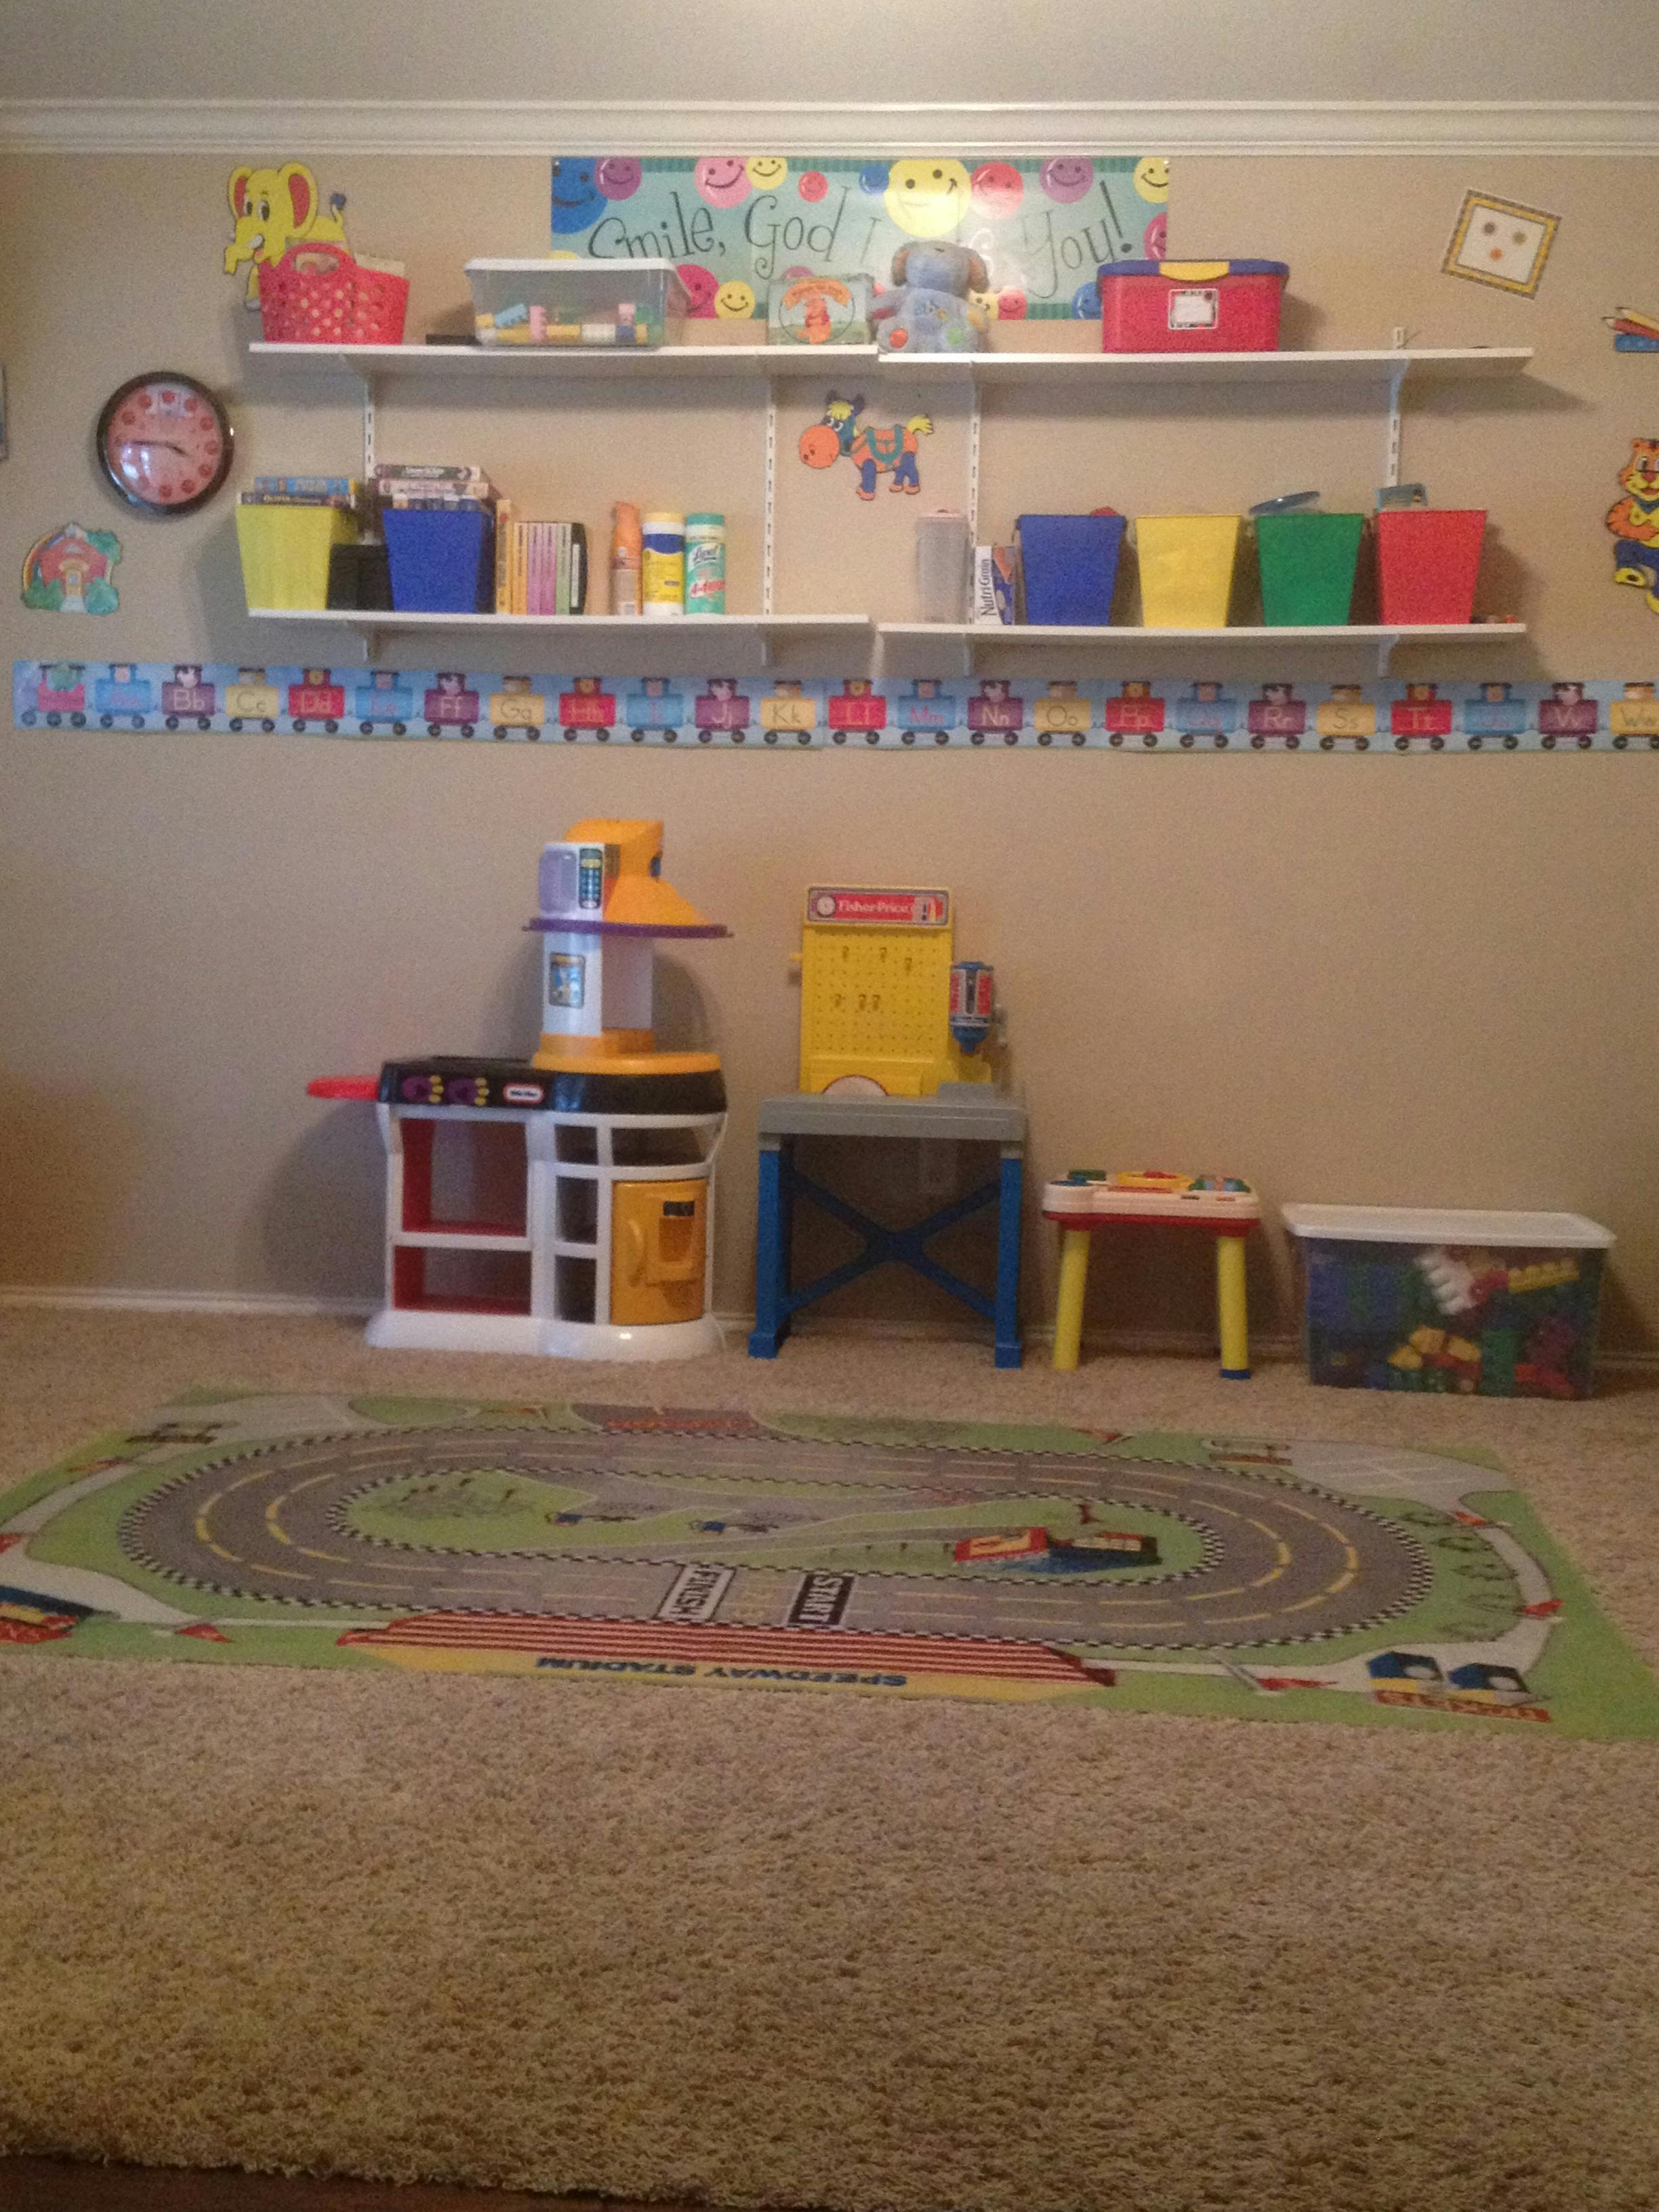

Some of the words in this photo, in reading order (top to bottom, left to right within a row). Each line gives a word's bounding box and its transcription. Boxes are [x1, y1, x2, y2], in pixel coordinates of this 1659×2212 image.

[744, 185, 853, 279] God
[1020, 180, 1132, 298] You!
[173, 689, 205, 712] Bb
[237, 691, 267, 713] Cc
[772, 700, 802, 724] Kk
[982, 704, 1010, 726] Nn
[1046, 704, 1079, 727] Oo
[1332, 707, 1359, 729] Ss
[669, 1568, 723, 1616] FINISH
[798, 1576, 844, 1623] START
[536, 1658, 696, 1676] STADIUM
[703, 1666, 907, 1687] SPEEDWAY
